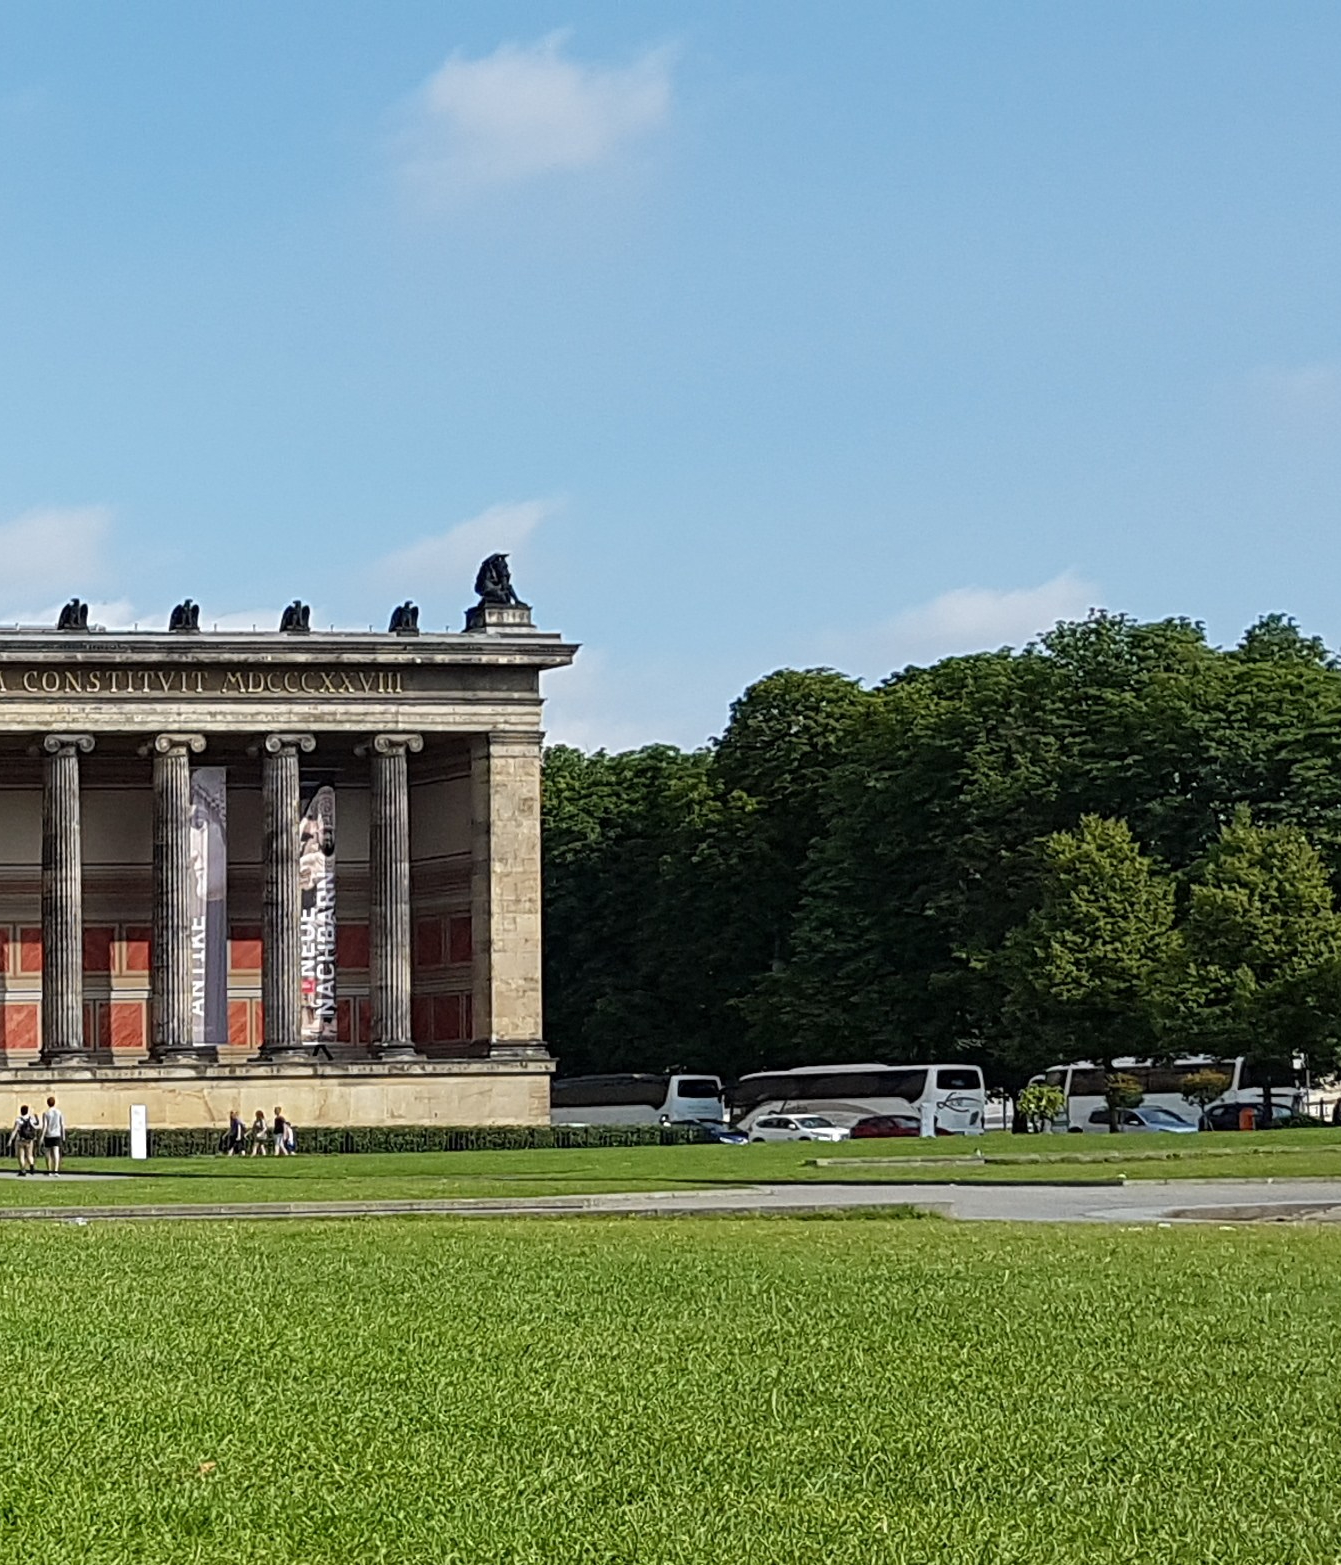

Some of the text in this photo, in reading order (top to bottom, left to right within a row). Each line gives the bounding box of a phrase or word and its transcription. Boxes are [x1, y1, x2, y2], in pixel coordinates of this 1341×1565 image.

[23, 670, 208, 693] CONSTITVIT
[221, 671, 403, 693] MDCCCXXVIII
[301, 907, 316, 977] NEUE
[316, 872, 335, 1018] NACHBARN
